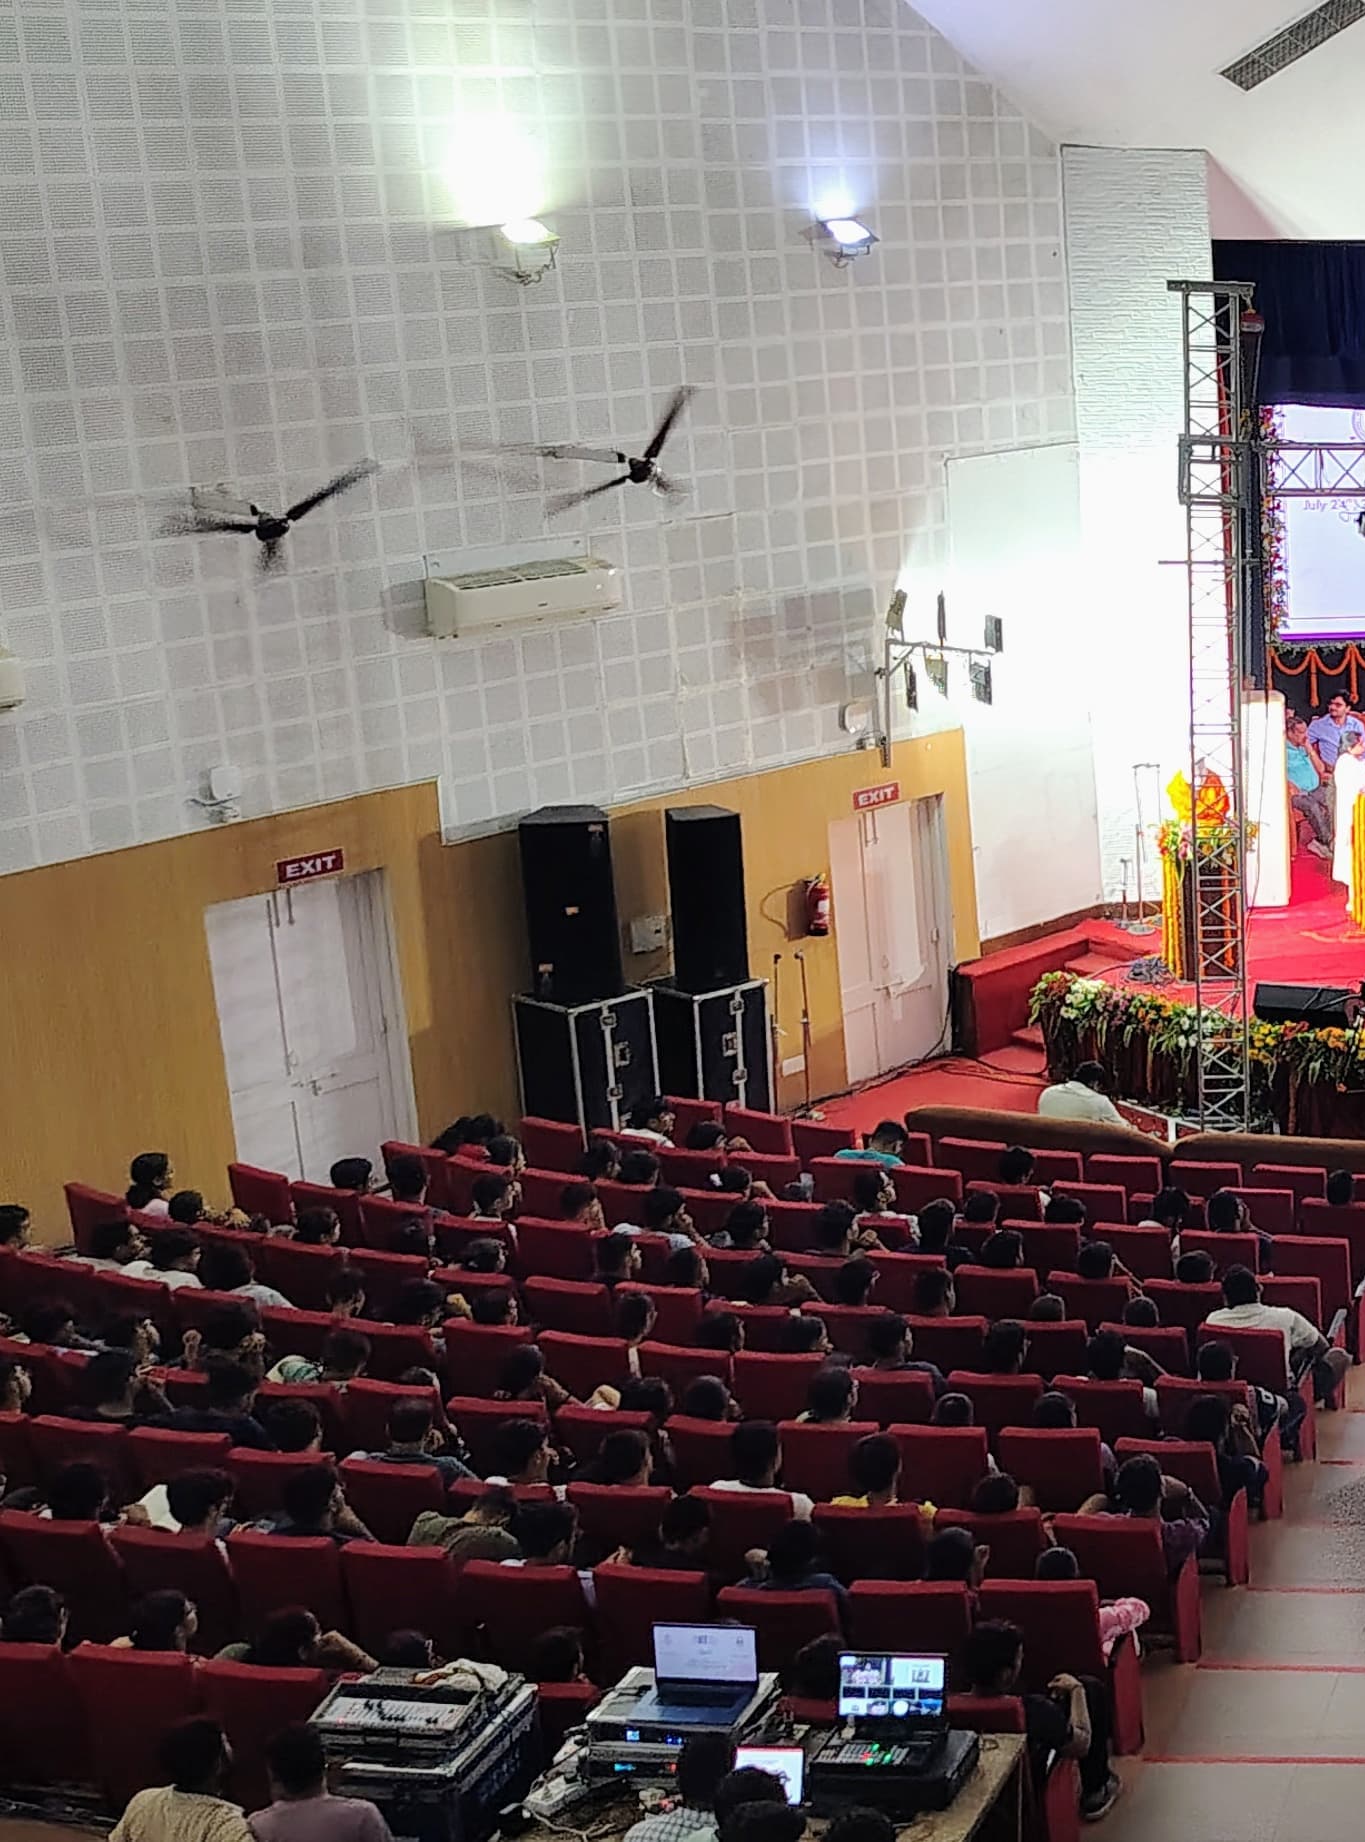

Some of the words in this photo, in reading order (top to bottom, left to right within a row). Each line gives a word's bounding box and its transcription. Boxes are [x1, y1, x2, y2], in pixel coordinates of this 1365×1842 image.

[1303, 499, 1328, 512] July
[858, 785, 895, 806] EXIT
[285, 854, 336, 878] EXIT
